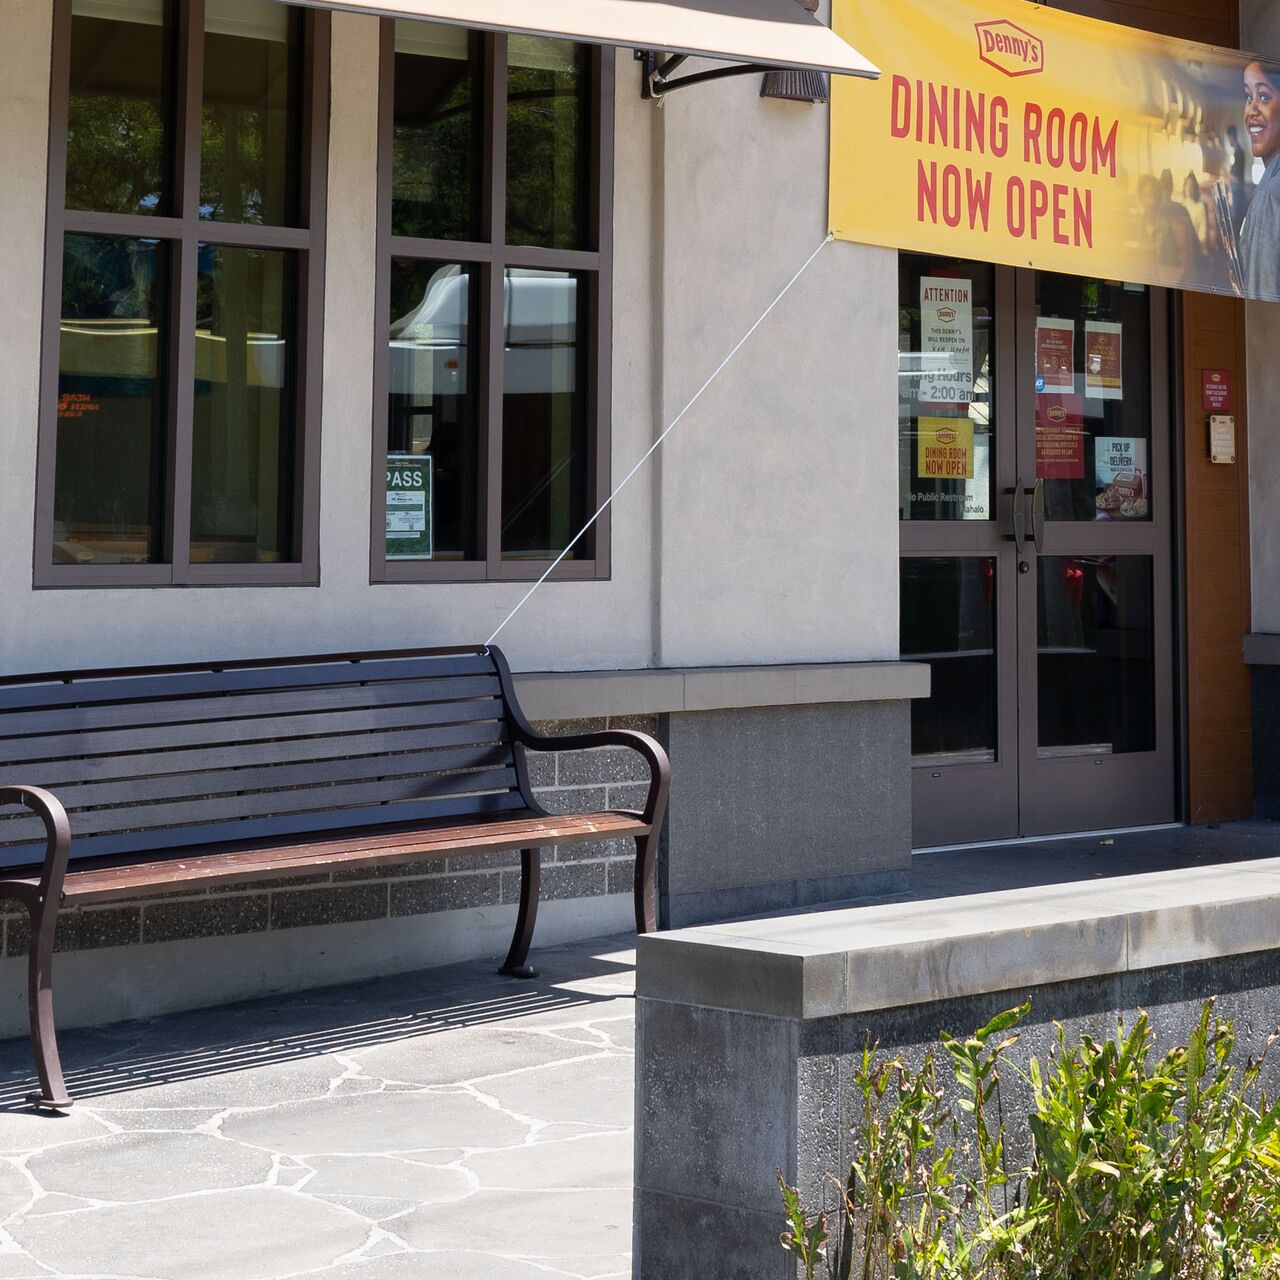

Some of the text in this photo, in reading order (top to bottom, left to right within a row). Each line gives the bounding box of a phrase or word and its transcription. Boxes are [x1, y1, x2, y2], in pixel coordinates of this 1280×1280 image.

[983, 29, 1039, 63] Denny's
[891, 74, 1119, 178] DINING ROOM
[917, 159, 1093, 249] NOW OPEN
[924, 287, 969, 303] ATTENTION
[937, 368, 972, 382] Hours
[930, 385, 956, 401] 2:00
[959, 390, 976, 401] am
[925, 447, 967, 459] DINING ROOM
[1112, 442, 1131, 452] PICK UP
[925, 460, 967, 475] NOW OPEN
[1109, 456, 1132, 466] DELIVERY
[917, 491, 939, 501] Public
